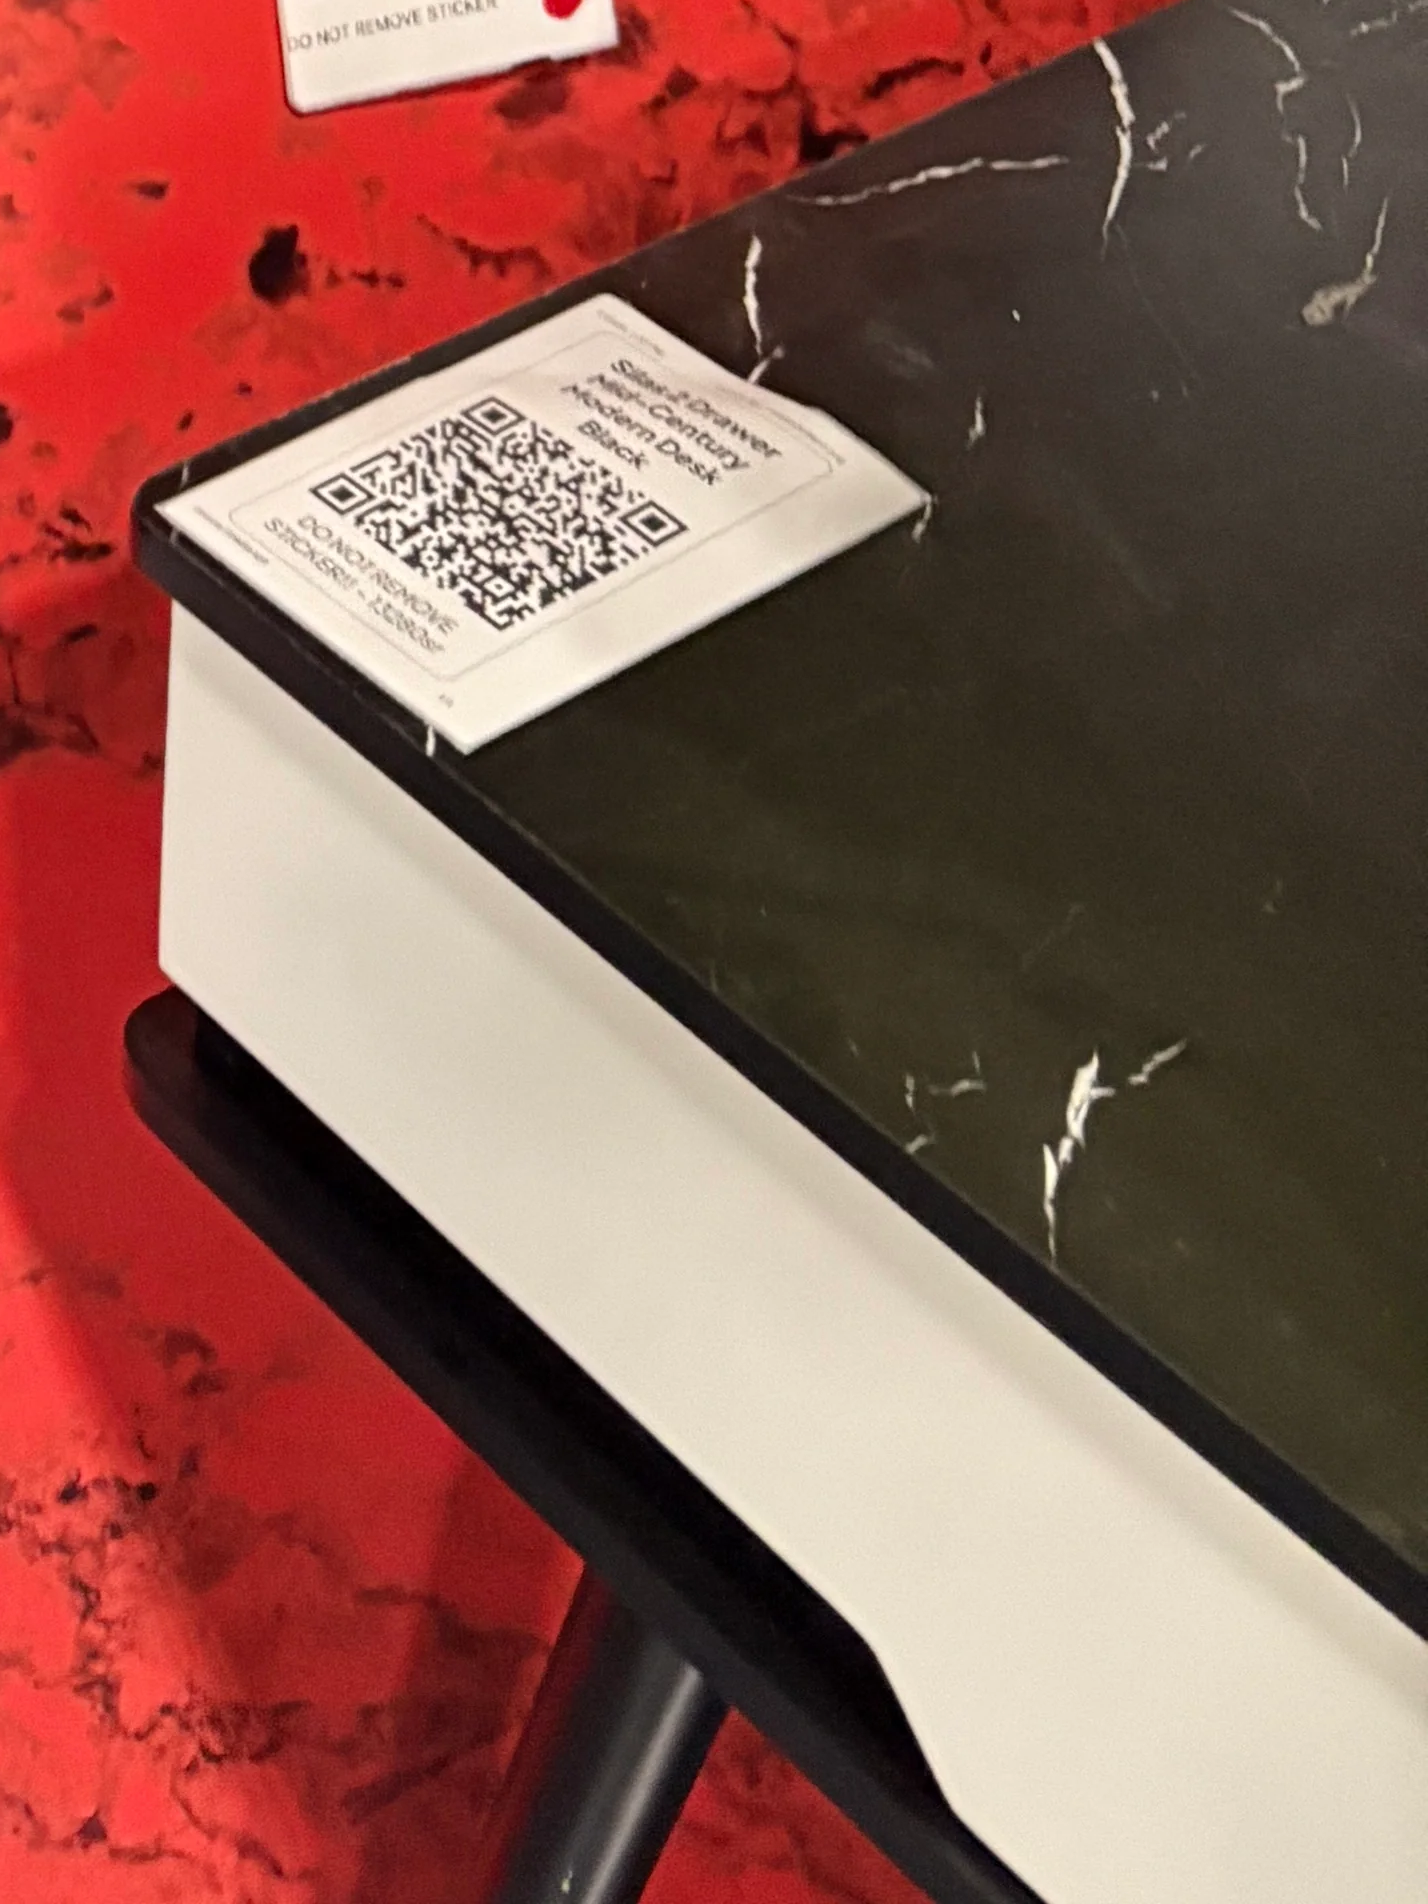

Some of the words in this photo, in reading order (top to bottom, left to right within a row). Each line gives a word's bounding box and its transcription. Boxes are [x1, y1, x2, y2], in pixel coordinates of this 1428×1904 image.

[316, 24, 349, 46] NOT
[355, 7, 423, 37] REMOVE
[559, 384, 657, 443] Modern
[654, 437, 723, 486] Desk
[577, 419, 650, 471] Black
[586, 373, 750, 471] Mid-Century
[686, 398, 783, 459] Drawer
[297, 513, 333, 542] DO
[328, 536, 375, 574] NOT
[370, 567, 460, 636] REMOVE
